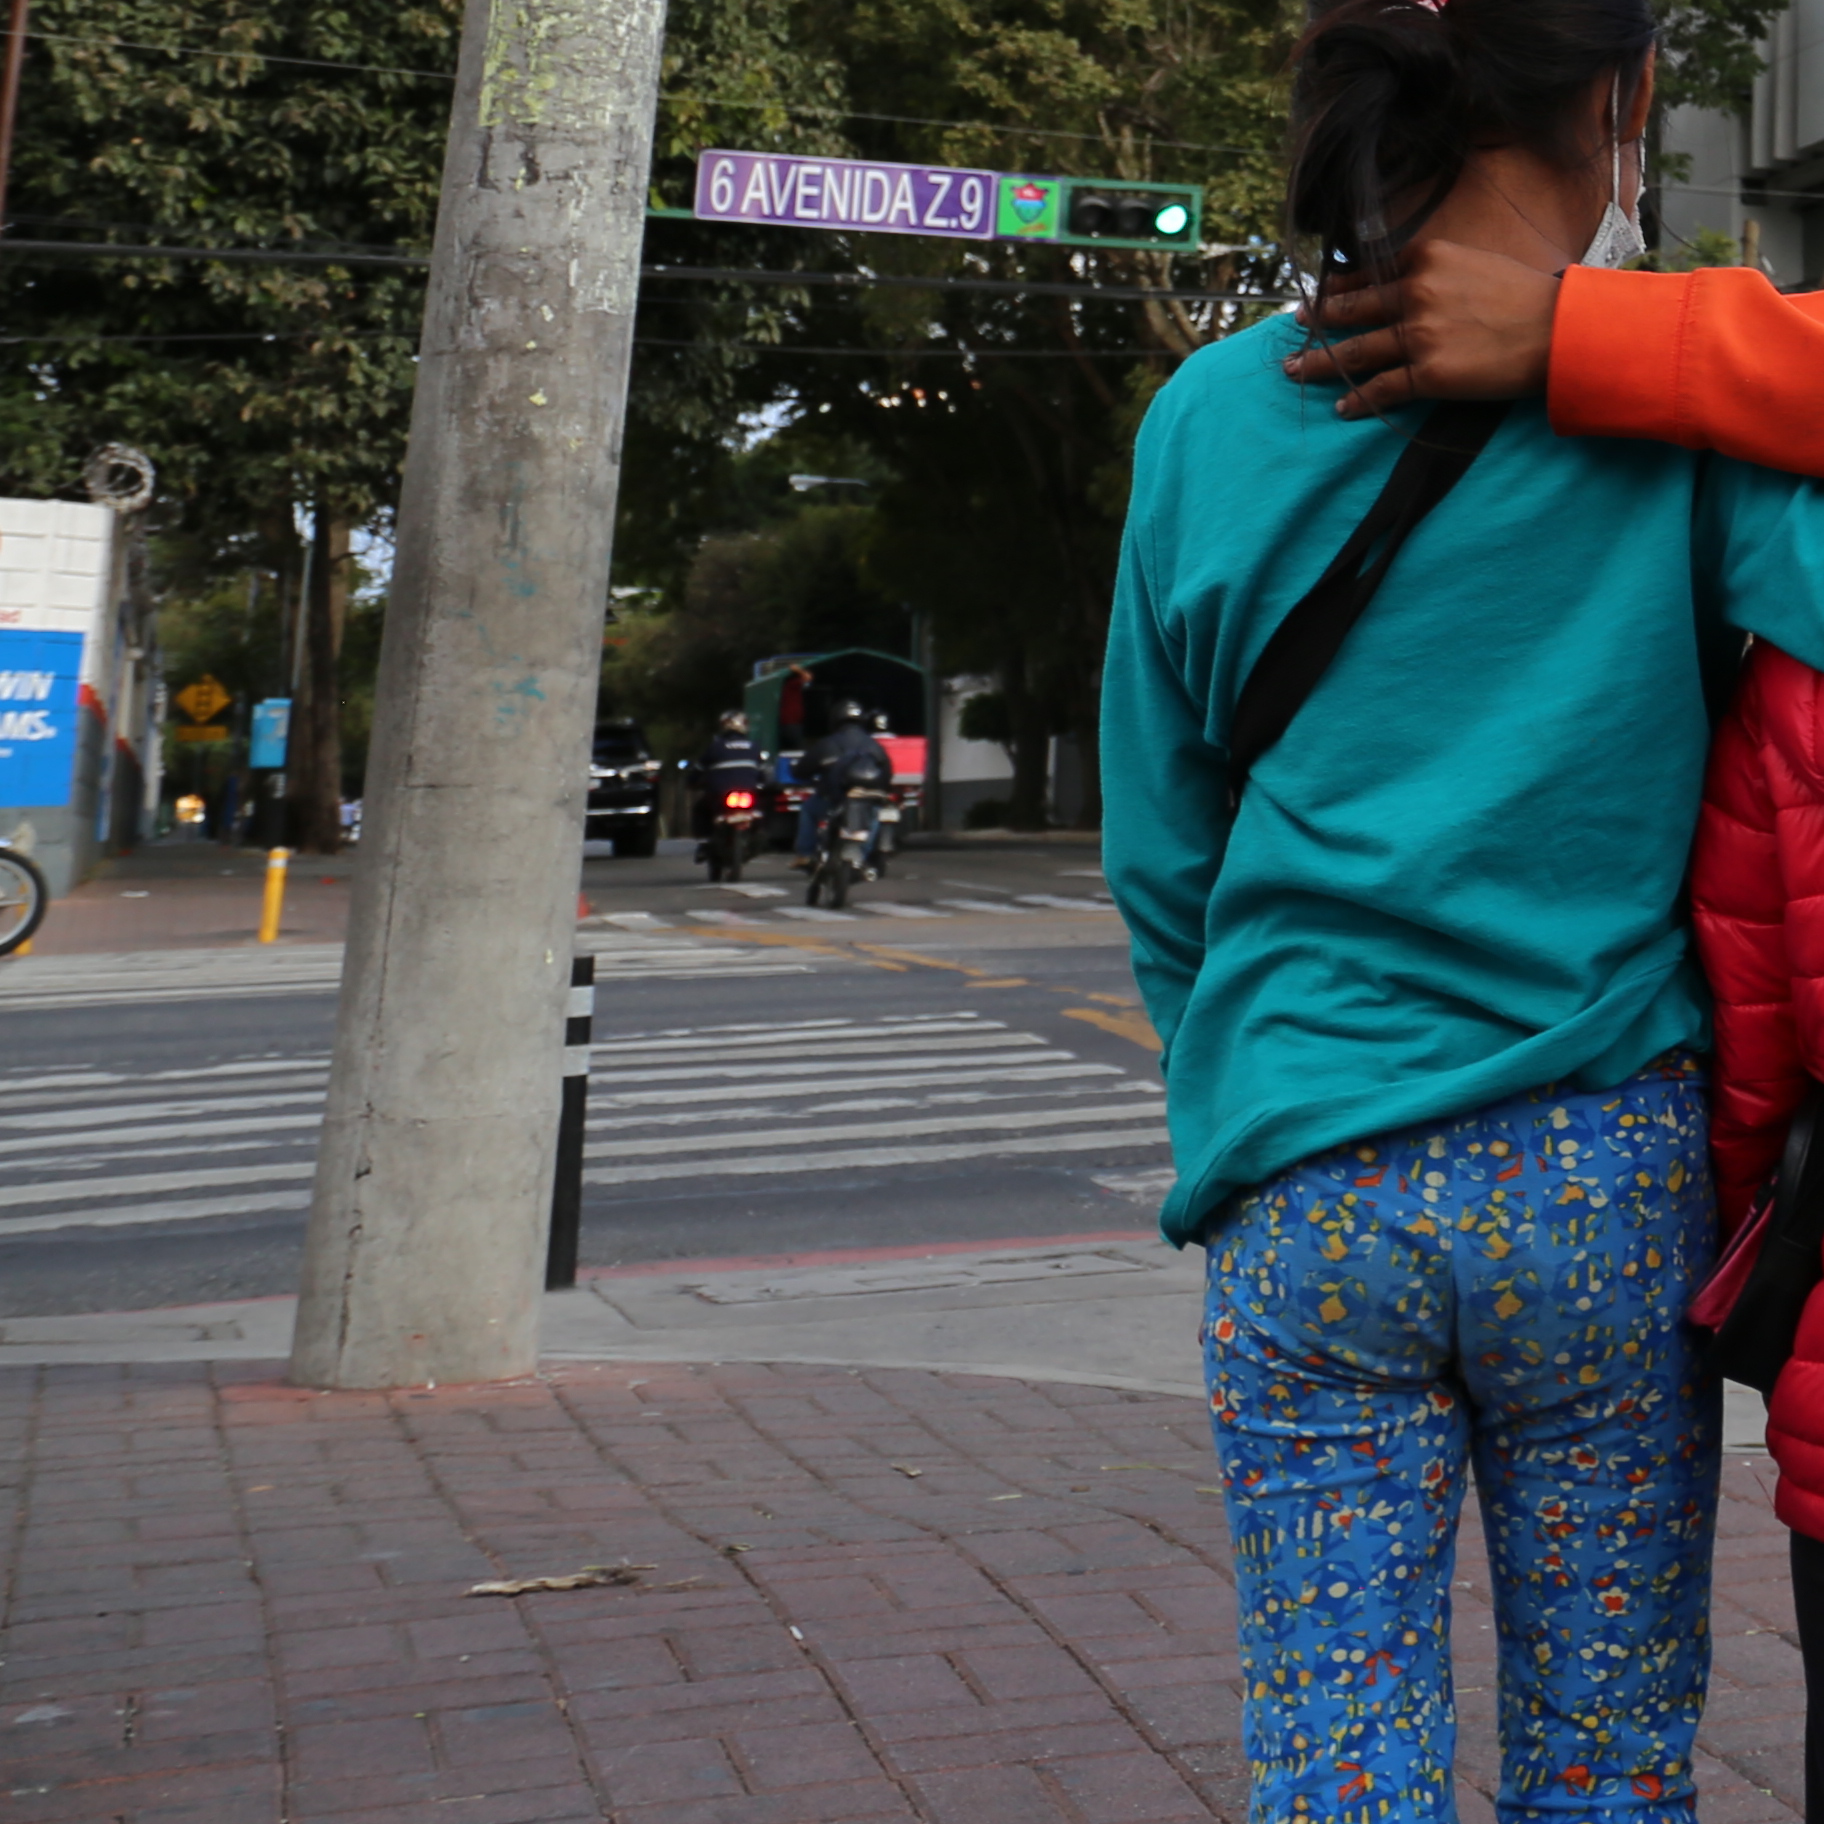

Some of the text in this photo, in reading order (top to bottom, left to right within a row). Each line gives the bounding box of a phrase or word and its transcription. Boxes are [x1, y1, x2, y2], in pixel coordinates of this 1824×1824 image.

[709, 158, 985, 231] 6 AVENIDA Z.9
